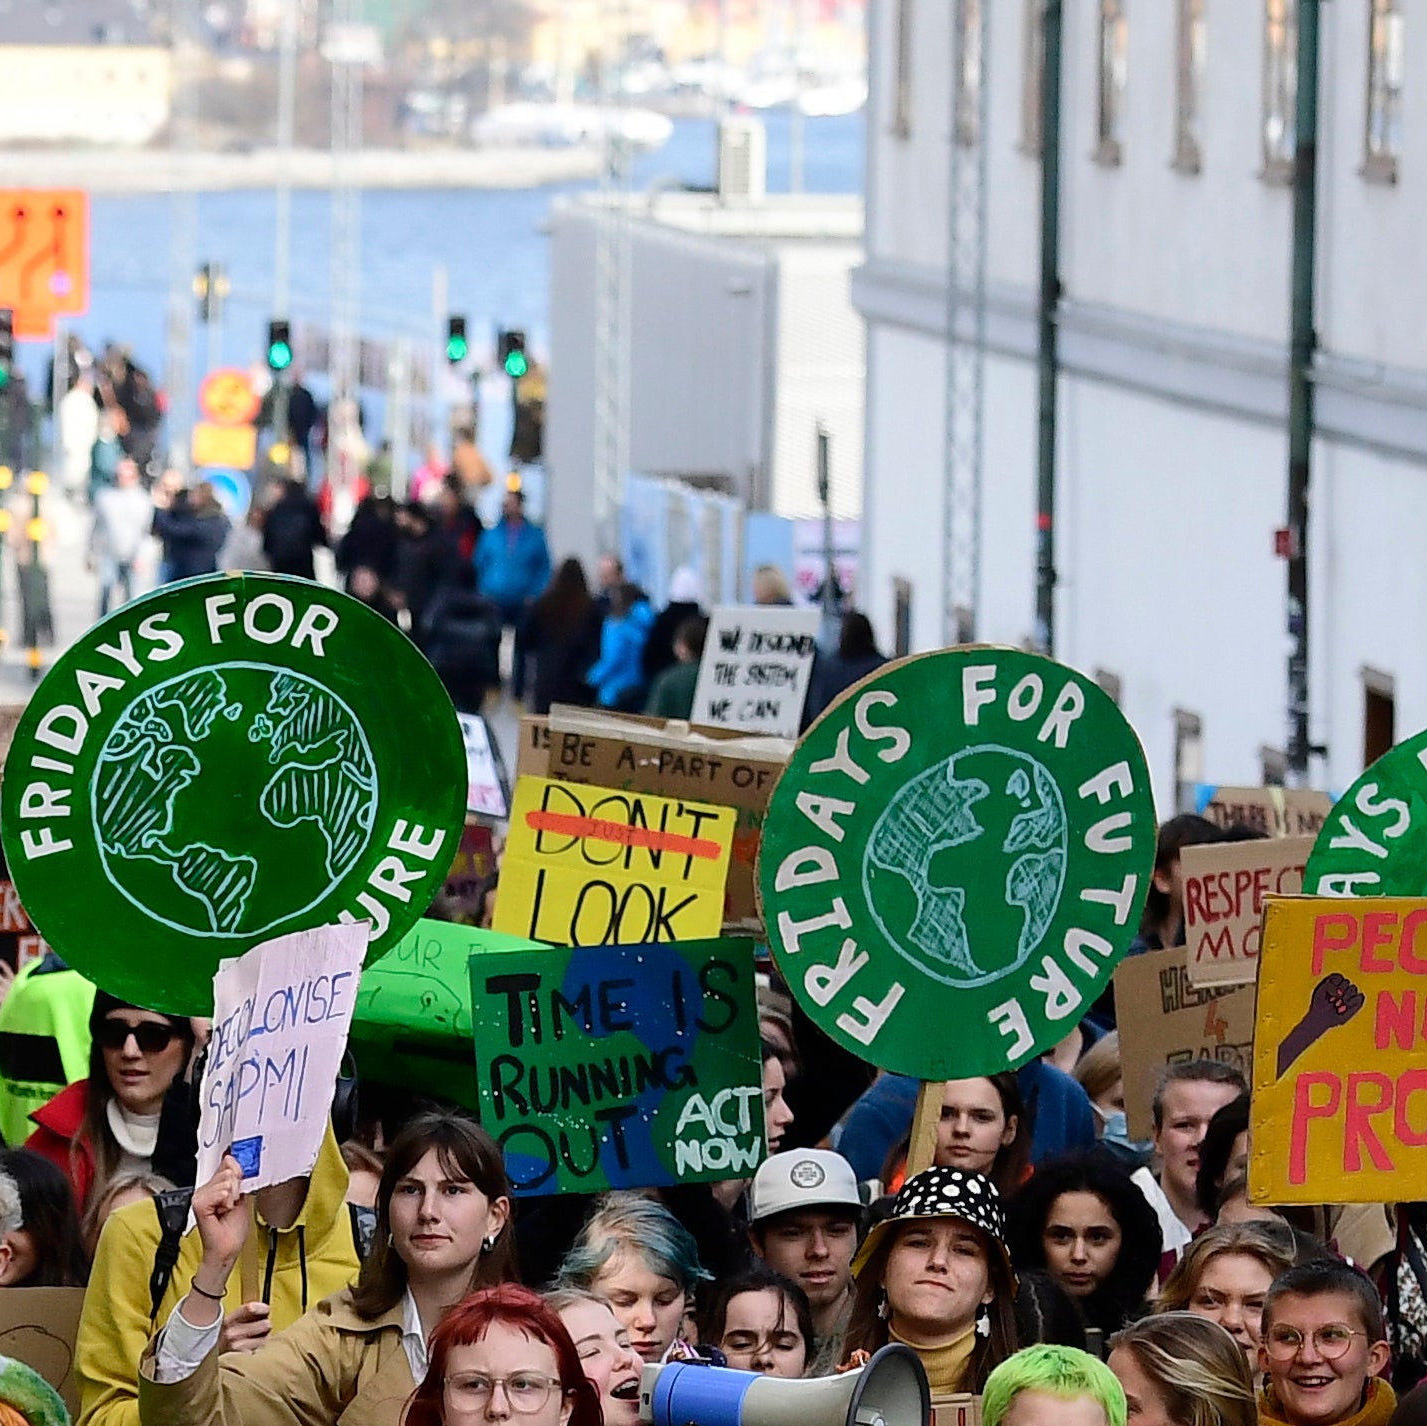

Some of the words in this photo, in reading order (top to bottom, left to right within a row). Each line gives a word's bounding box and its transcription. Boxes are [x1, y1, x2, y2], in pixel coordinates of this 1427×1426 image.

[20, 612, 185, 860] FRIDAYS
[204, 593, 339, 656] FOR
[962, 664, 1085, 748] FOR
[561, 734, 596, 767] BE
[617, 745, 636, 772] A
[658, 751, 722, 782] PART
[731, 765, 772, 791] OF
[535, 784, 720, 882] DON'T
[774, 690, 912, 1046] FRIDAYS
[529, 868, 699, 948] LOOK
[987, 761, 1138, 1062] FUTURE
[207, 971, 352, 1077] DECOLONISE
[485, 973, 635, 1048] TIME
[670, 959, 739, 1035] IS
[490, 1046, 698, 1120] RUNNING
[675, 1086, 762, 1137] ACT
[498, 1105, 638, 1190] OUT
[675, 1136, 761, 1176] NOW
